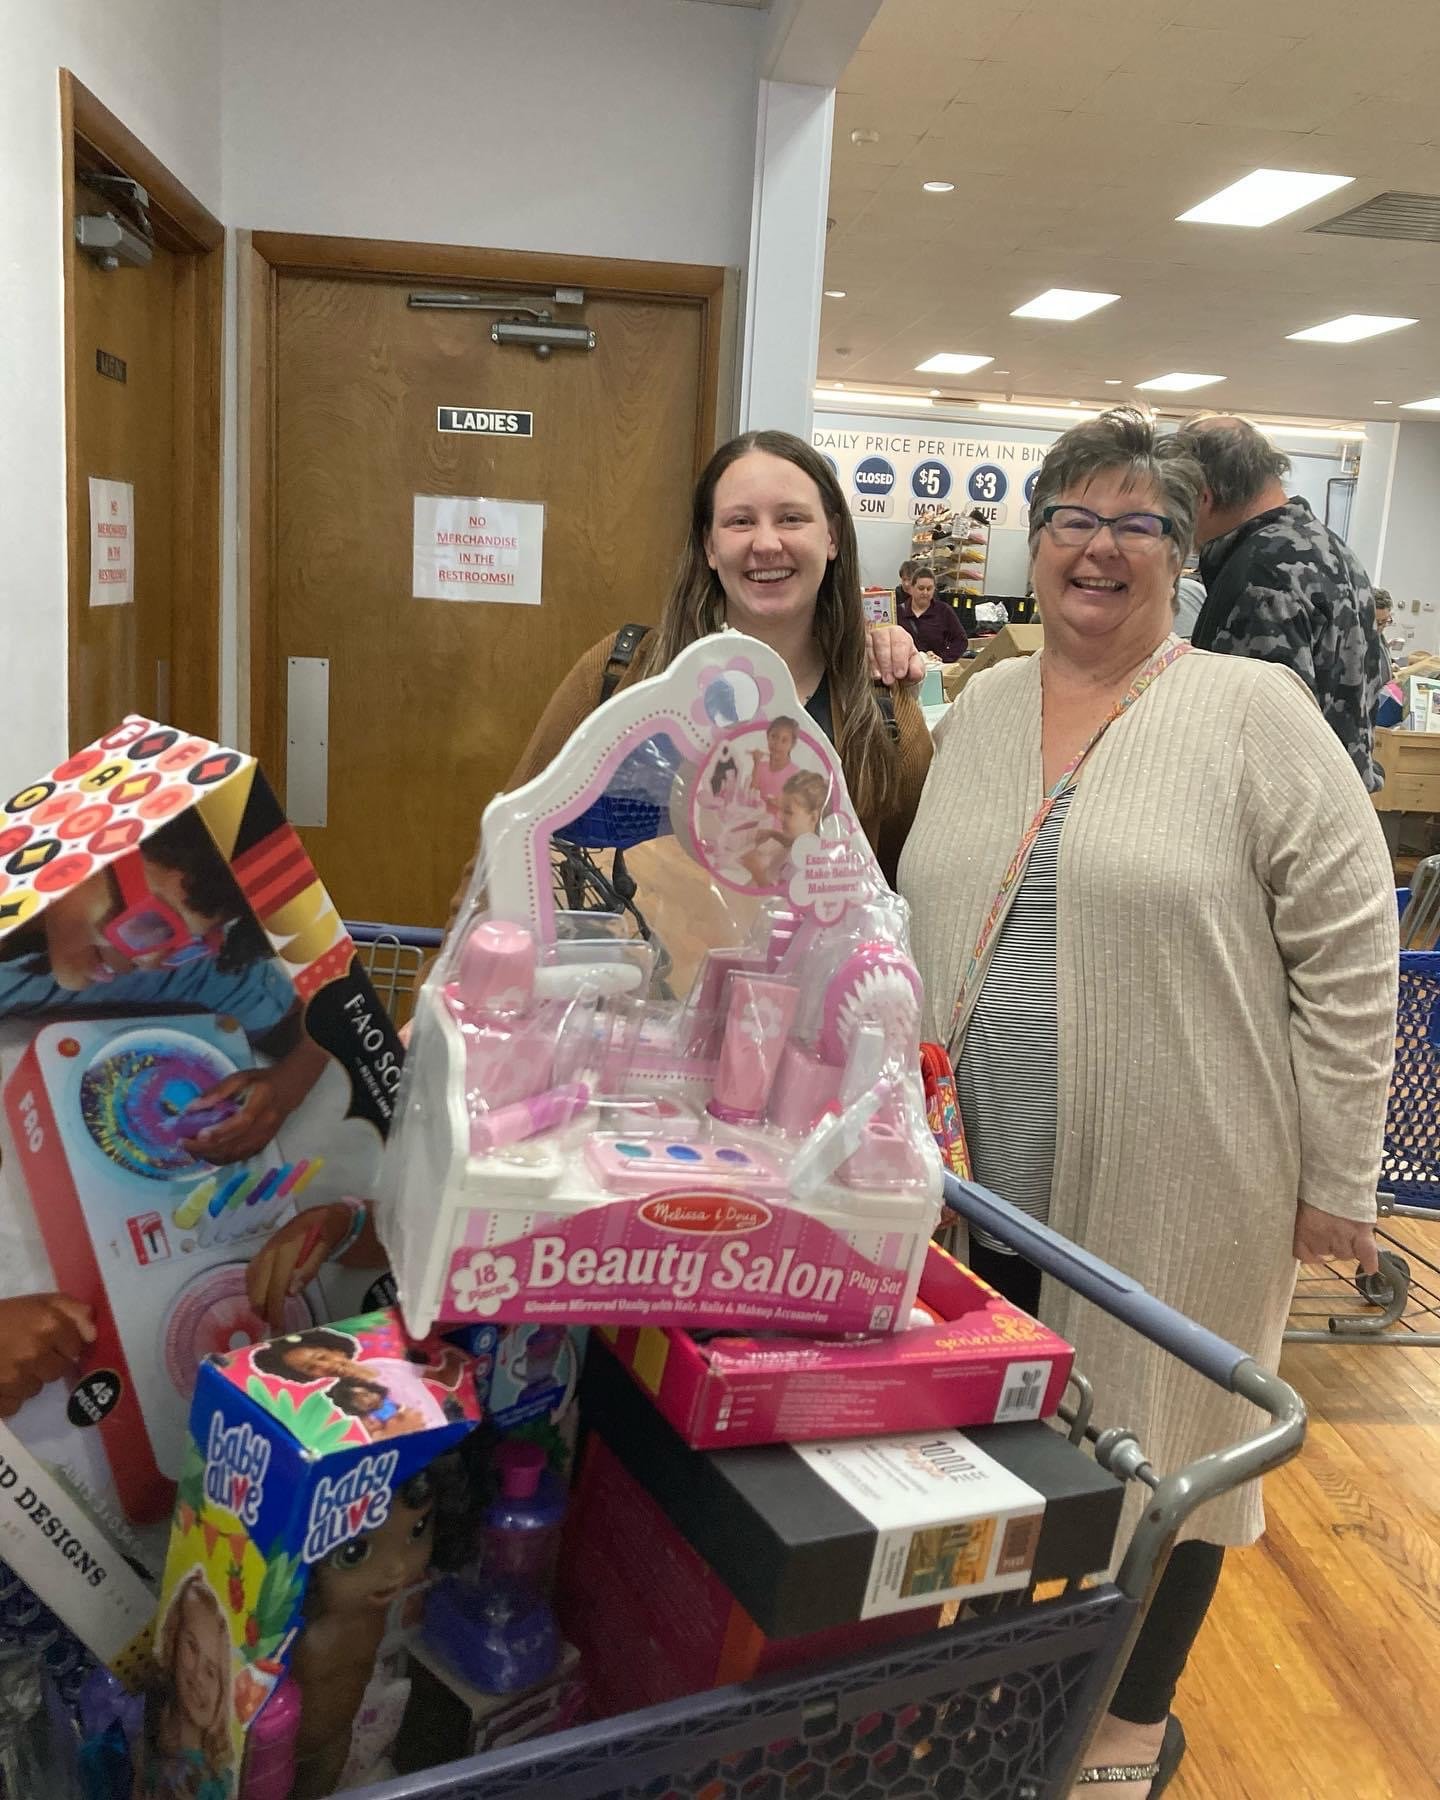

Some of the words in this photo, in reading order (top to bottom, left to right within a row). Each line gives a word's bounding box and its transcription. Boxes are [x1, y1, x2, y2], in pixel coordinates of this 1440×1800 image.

[452, 411, 518, 432] LADIES
[814, 433, 859, 449] DAILY
[866, 436, 910, 453] PRICE
[918, 440, 945, 455] PER
[952, 442, 989, 459] ITEM
[998, 445, 1015, 461] IN
[856, 471, 894, 485] CLOSED
[919, 468, 940, 495] $5
[975, 472, 997, 498] $3
[859, 499, 885, 513] SUN
[469, 516, 486, 528] NO
[437, 533, 518, 547] MERCHANDISE
[459, 553, 471, 563] IN
[475, 554, 495, 565] THE
[438, 570, 514, 584] RESTROOMS!!
[18, 1090, 44, 1153] FAO
[655, 1203, 711, 1222] Melissa
[726, 1206, 757, 1228] Doug
[475, 1264, 497, 1286] 18
[526, 1236, 708, 1298] Beauty
[711, 1240, 844, 1302] Salon
[849, 1270, 879, 1296] Play
[879, 1276, 902, 1295] Set
[208, 1410, 271, 1484] baby
[920, 1440, 976, 1473] 1000
[309, 1450, 399, 1528] baby
[951, 1470, 990, 1484] PIECE
[206, 1464, 263, 1526] alive
[15, 1487, 107, 1587] DESIGNS
[303, 1487, 393, 1563] alive
